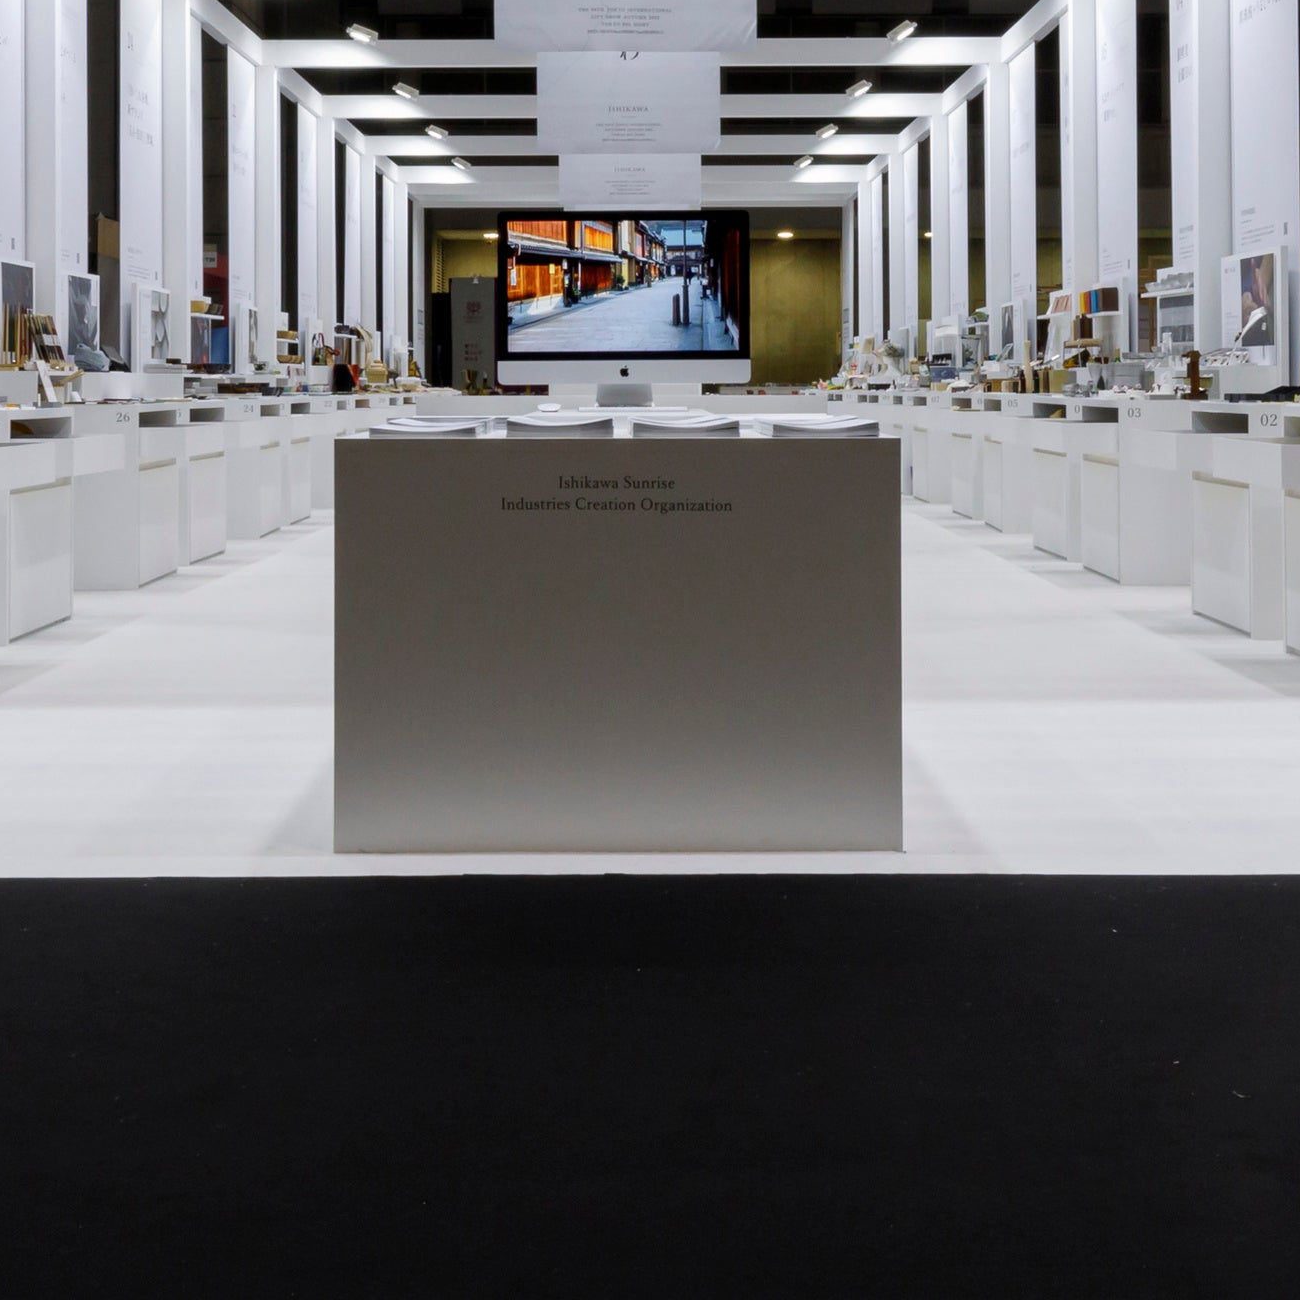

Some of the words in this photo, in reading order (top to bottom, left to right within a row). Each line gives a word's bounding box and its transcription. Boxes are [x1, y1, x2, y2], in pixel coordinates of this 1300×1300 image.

[608, 105, 650, 113] ISHIKAWA
[243, 404, 255, 414] 24
[1007, 400, 1019, 408] 05
[116, 411, 131, 424] 26
[1127, 406, 1142, 419] 03
[1260, 413, 1278, 428] 02
[559, 475, 619, 490] Ishikawa
[624, 475, 676, 490] Sunrise
[501, 496, 570, 511] Industries
[575, 497, 635, 511] Creation
[641, 497, 733, 515] Organization
